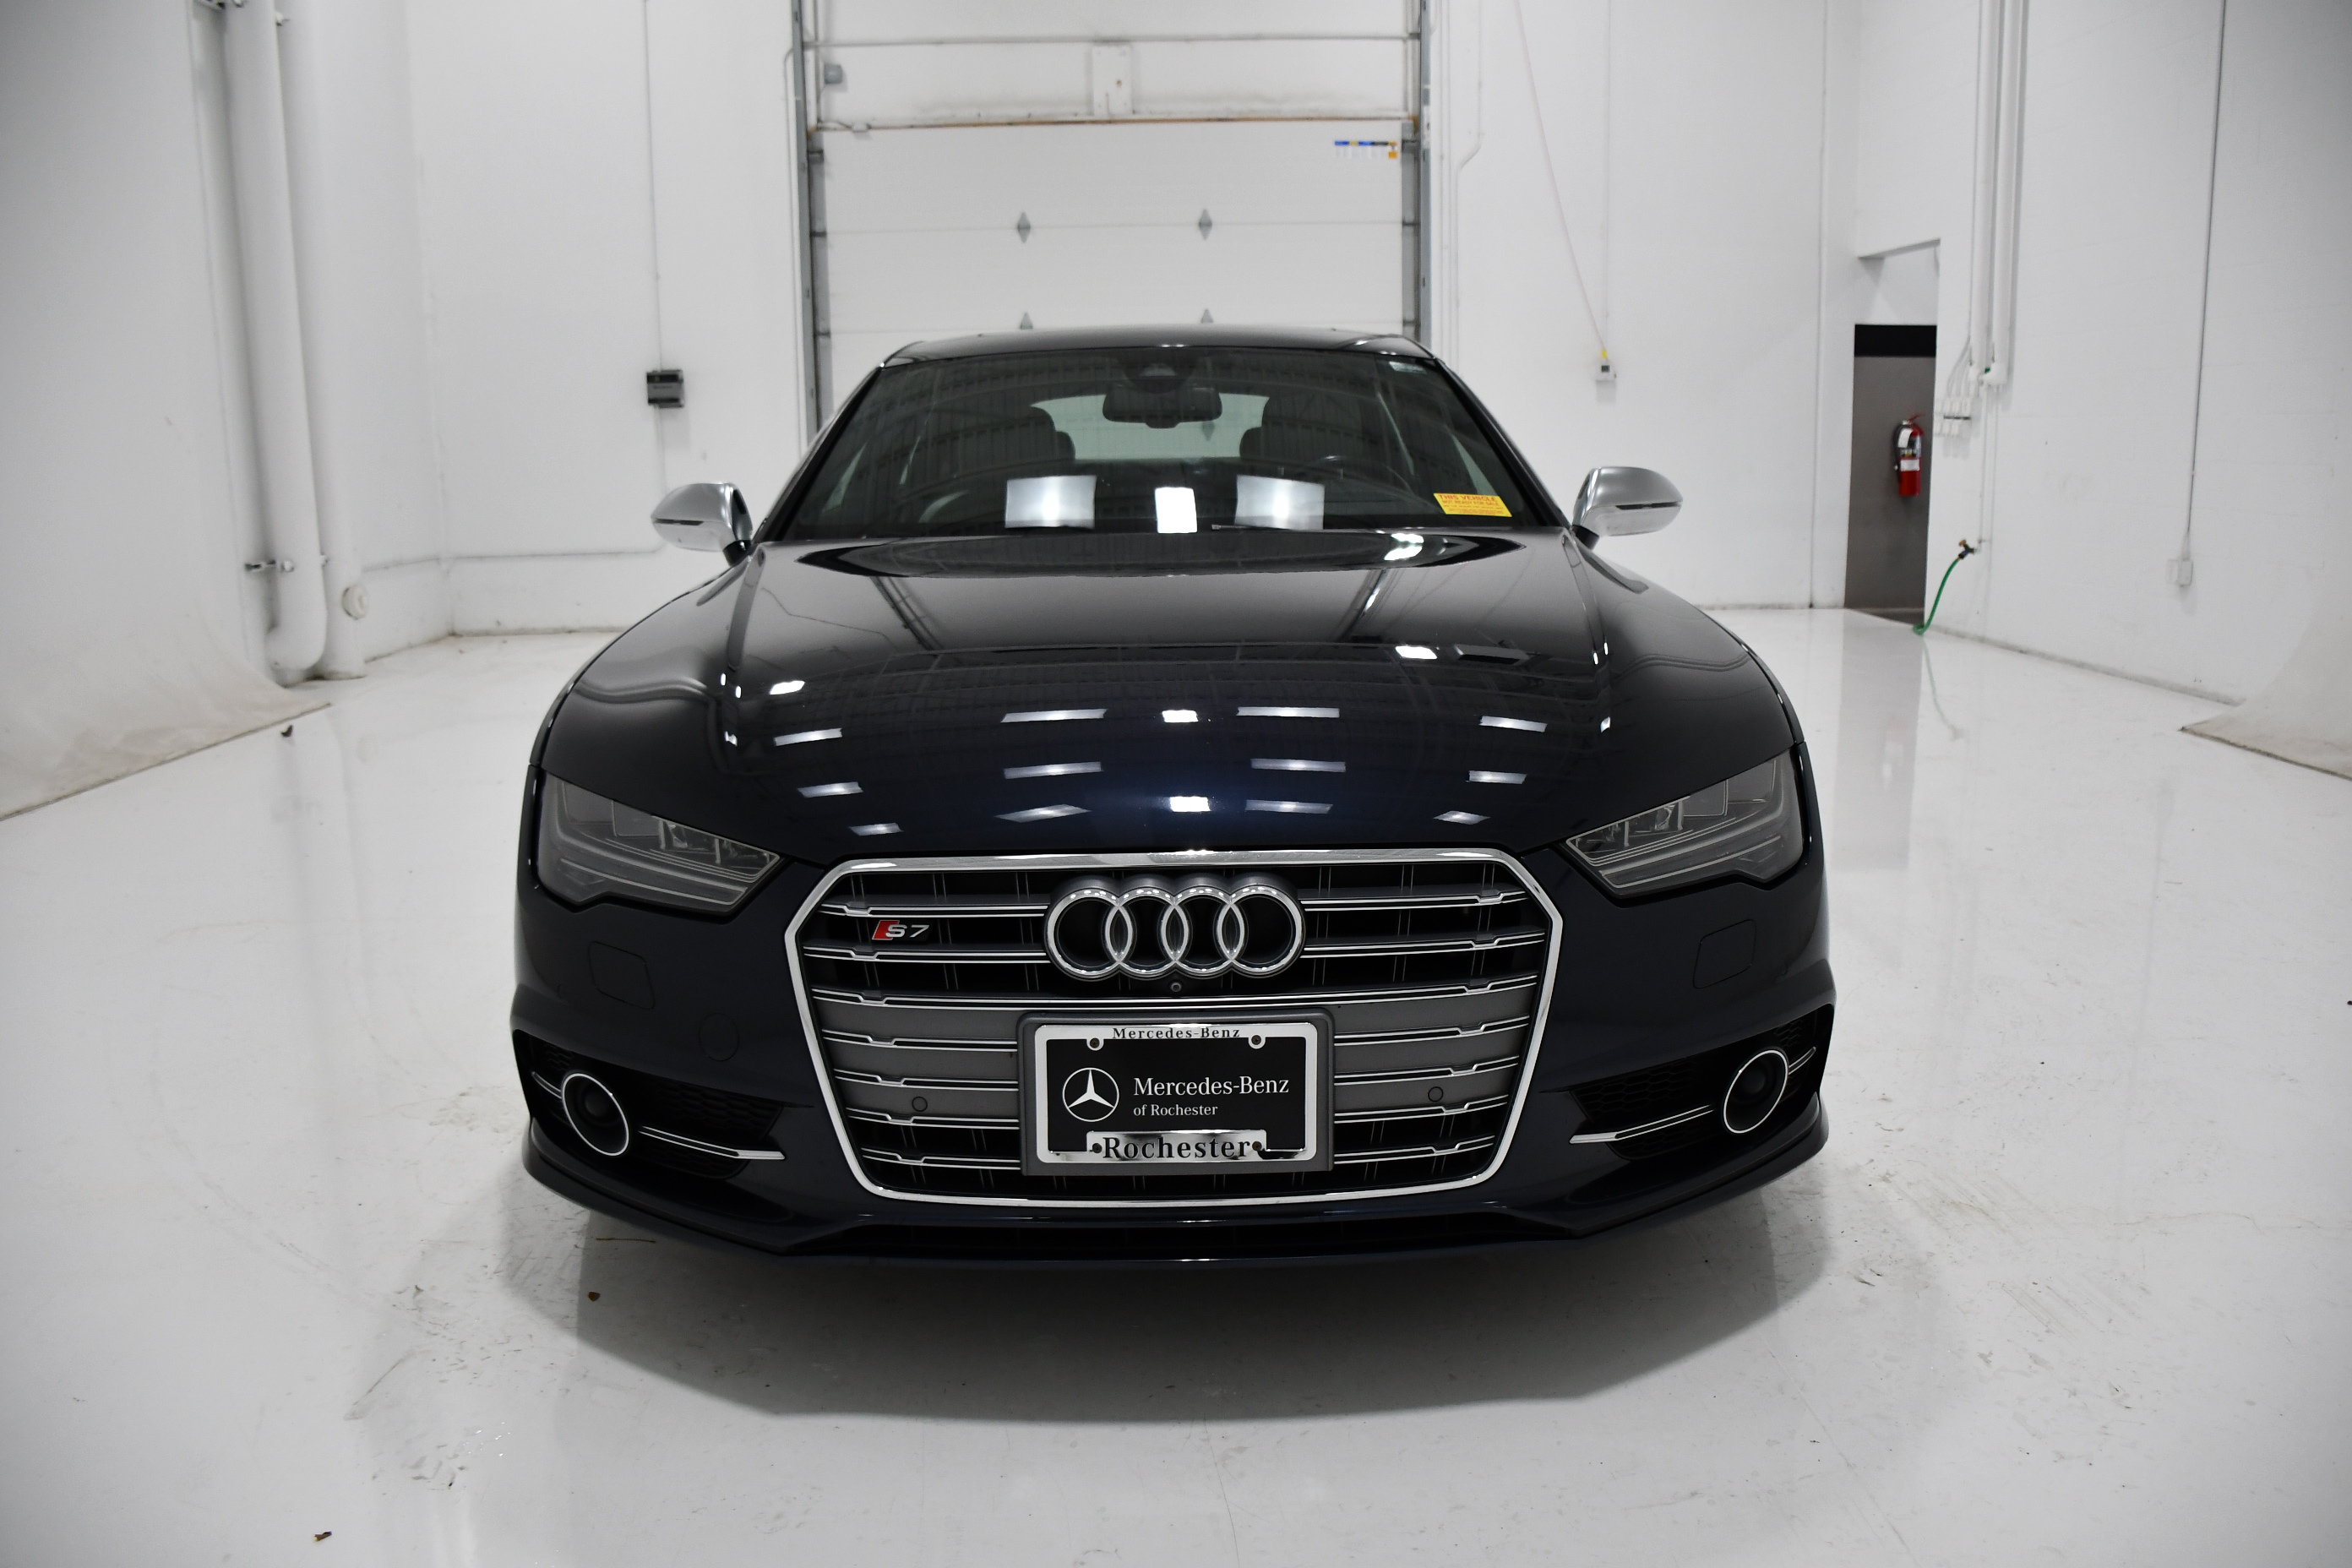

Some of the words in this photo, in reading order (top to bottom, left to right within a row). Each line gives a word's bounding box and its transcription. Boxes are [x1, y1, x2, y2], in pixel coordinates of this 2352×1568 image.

[884, 923, 930, 939] S7
[1112, 1027, 1241, 1039] Mercedes-Benz
[1134, 1075, 1290, 1096] Mercedes-Benz
[1133, 1104, 1149, 1116] of
[1150, 1104, 1219, 1116] Rochester
[1102, 1137, 1251, 1159] Rochester
